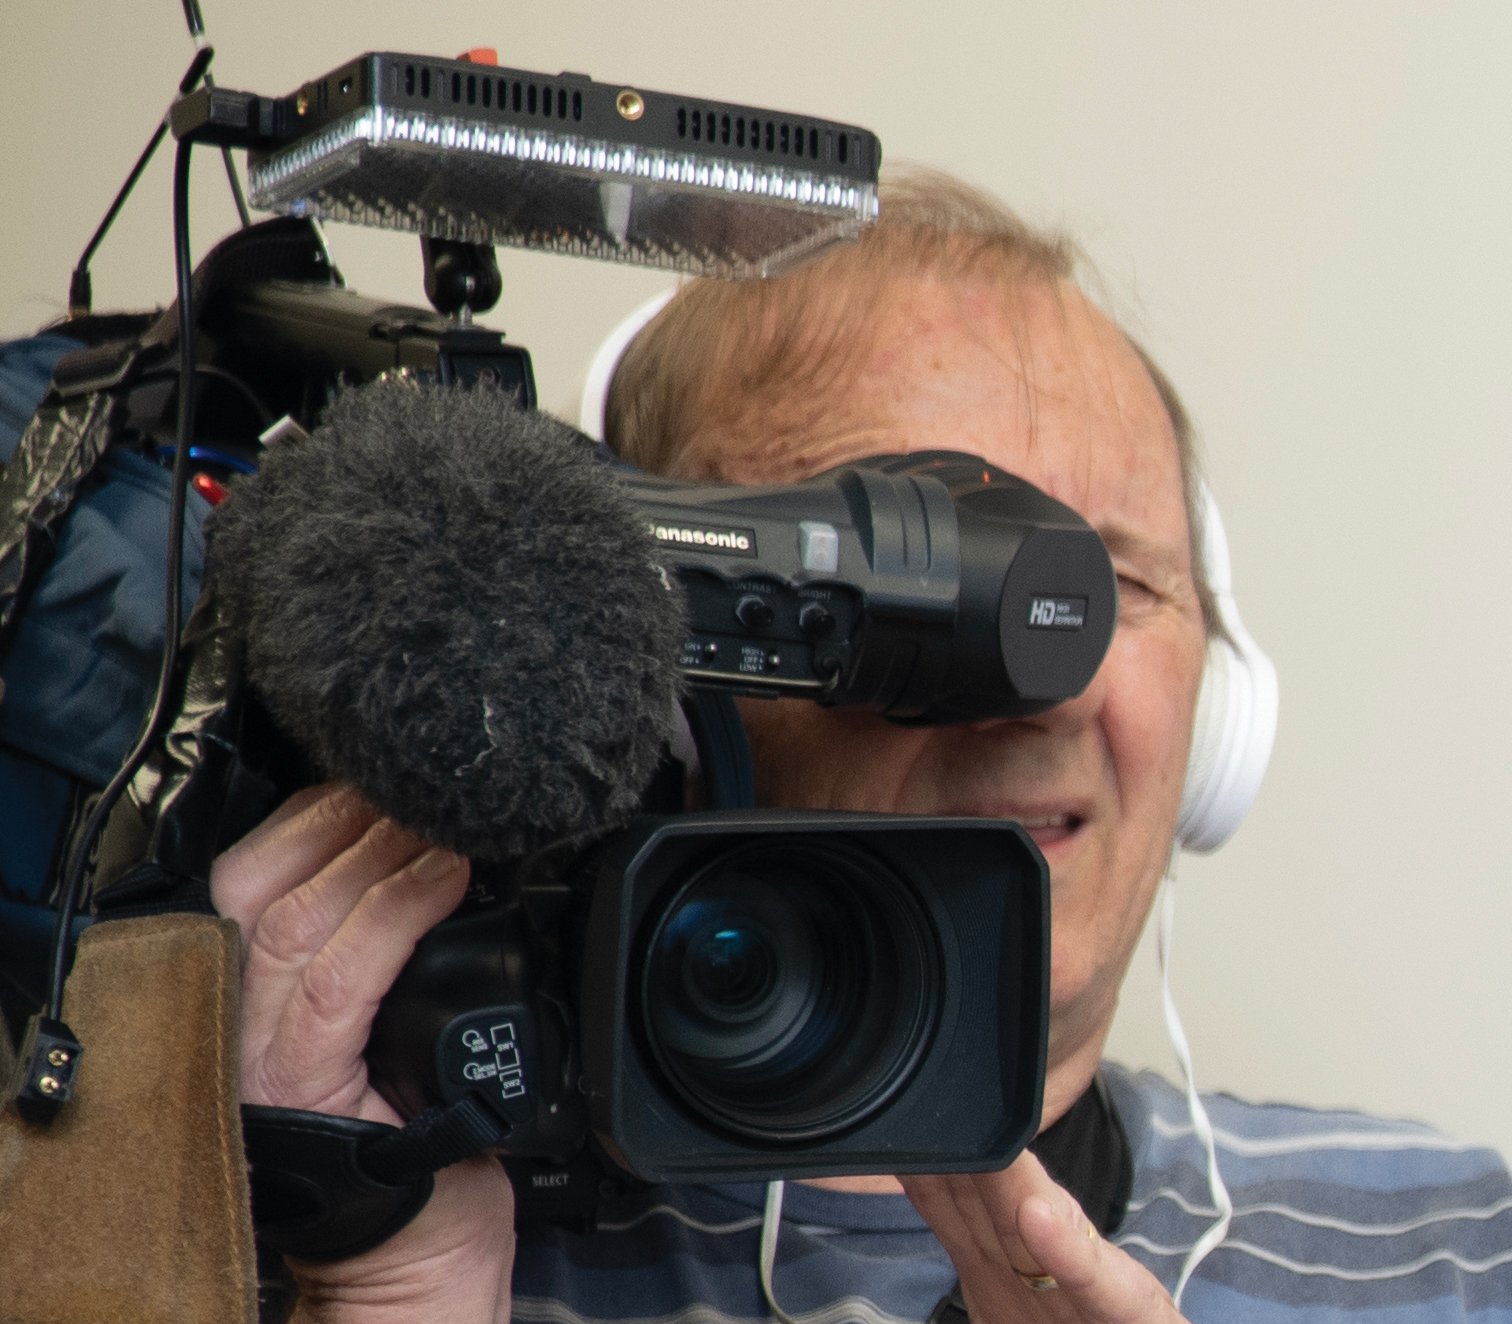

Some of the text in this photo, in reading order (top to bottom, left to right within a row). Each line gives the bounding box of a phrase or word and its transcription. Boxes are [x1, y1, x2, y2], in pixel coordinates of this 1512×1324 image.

[1029, 600, 1056, 625] HD
[497, 1041, 514, 1052] SW1
[503, 1079, 521, 1090] SW2
[532, 1174, 569, 1187] SELECT
